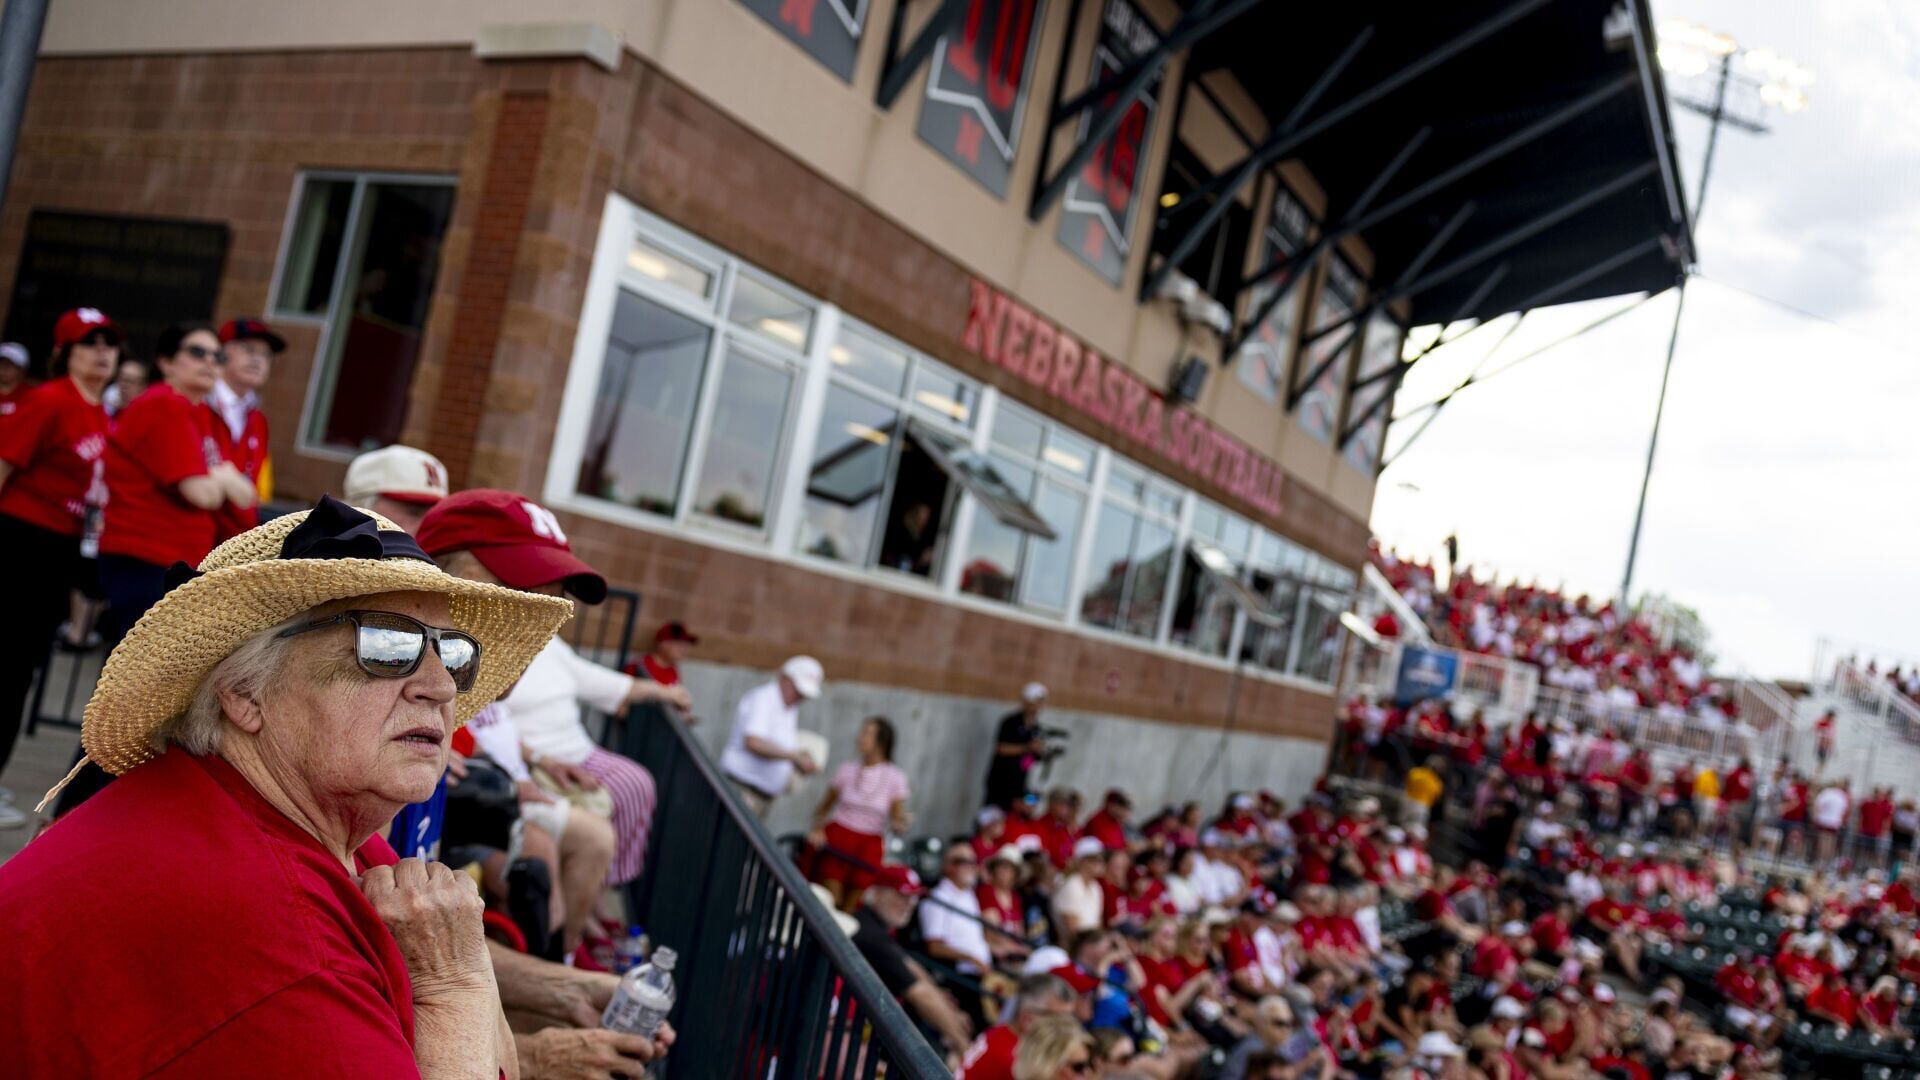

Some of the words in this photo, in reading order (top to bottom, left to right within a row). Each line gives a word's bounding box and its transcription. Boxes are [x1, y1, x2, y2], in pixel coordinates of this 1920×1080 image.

[961, 278, 1164, 449] NEBRASKA
[1167, 407, 1284, 517] SOFTBALL
[520, 501, 568, 546] N
